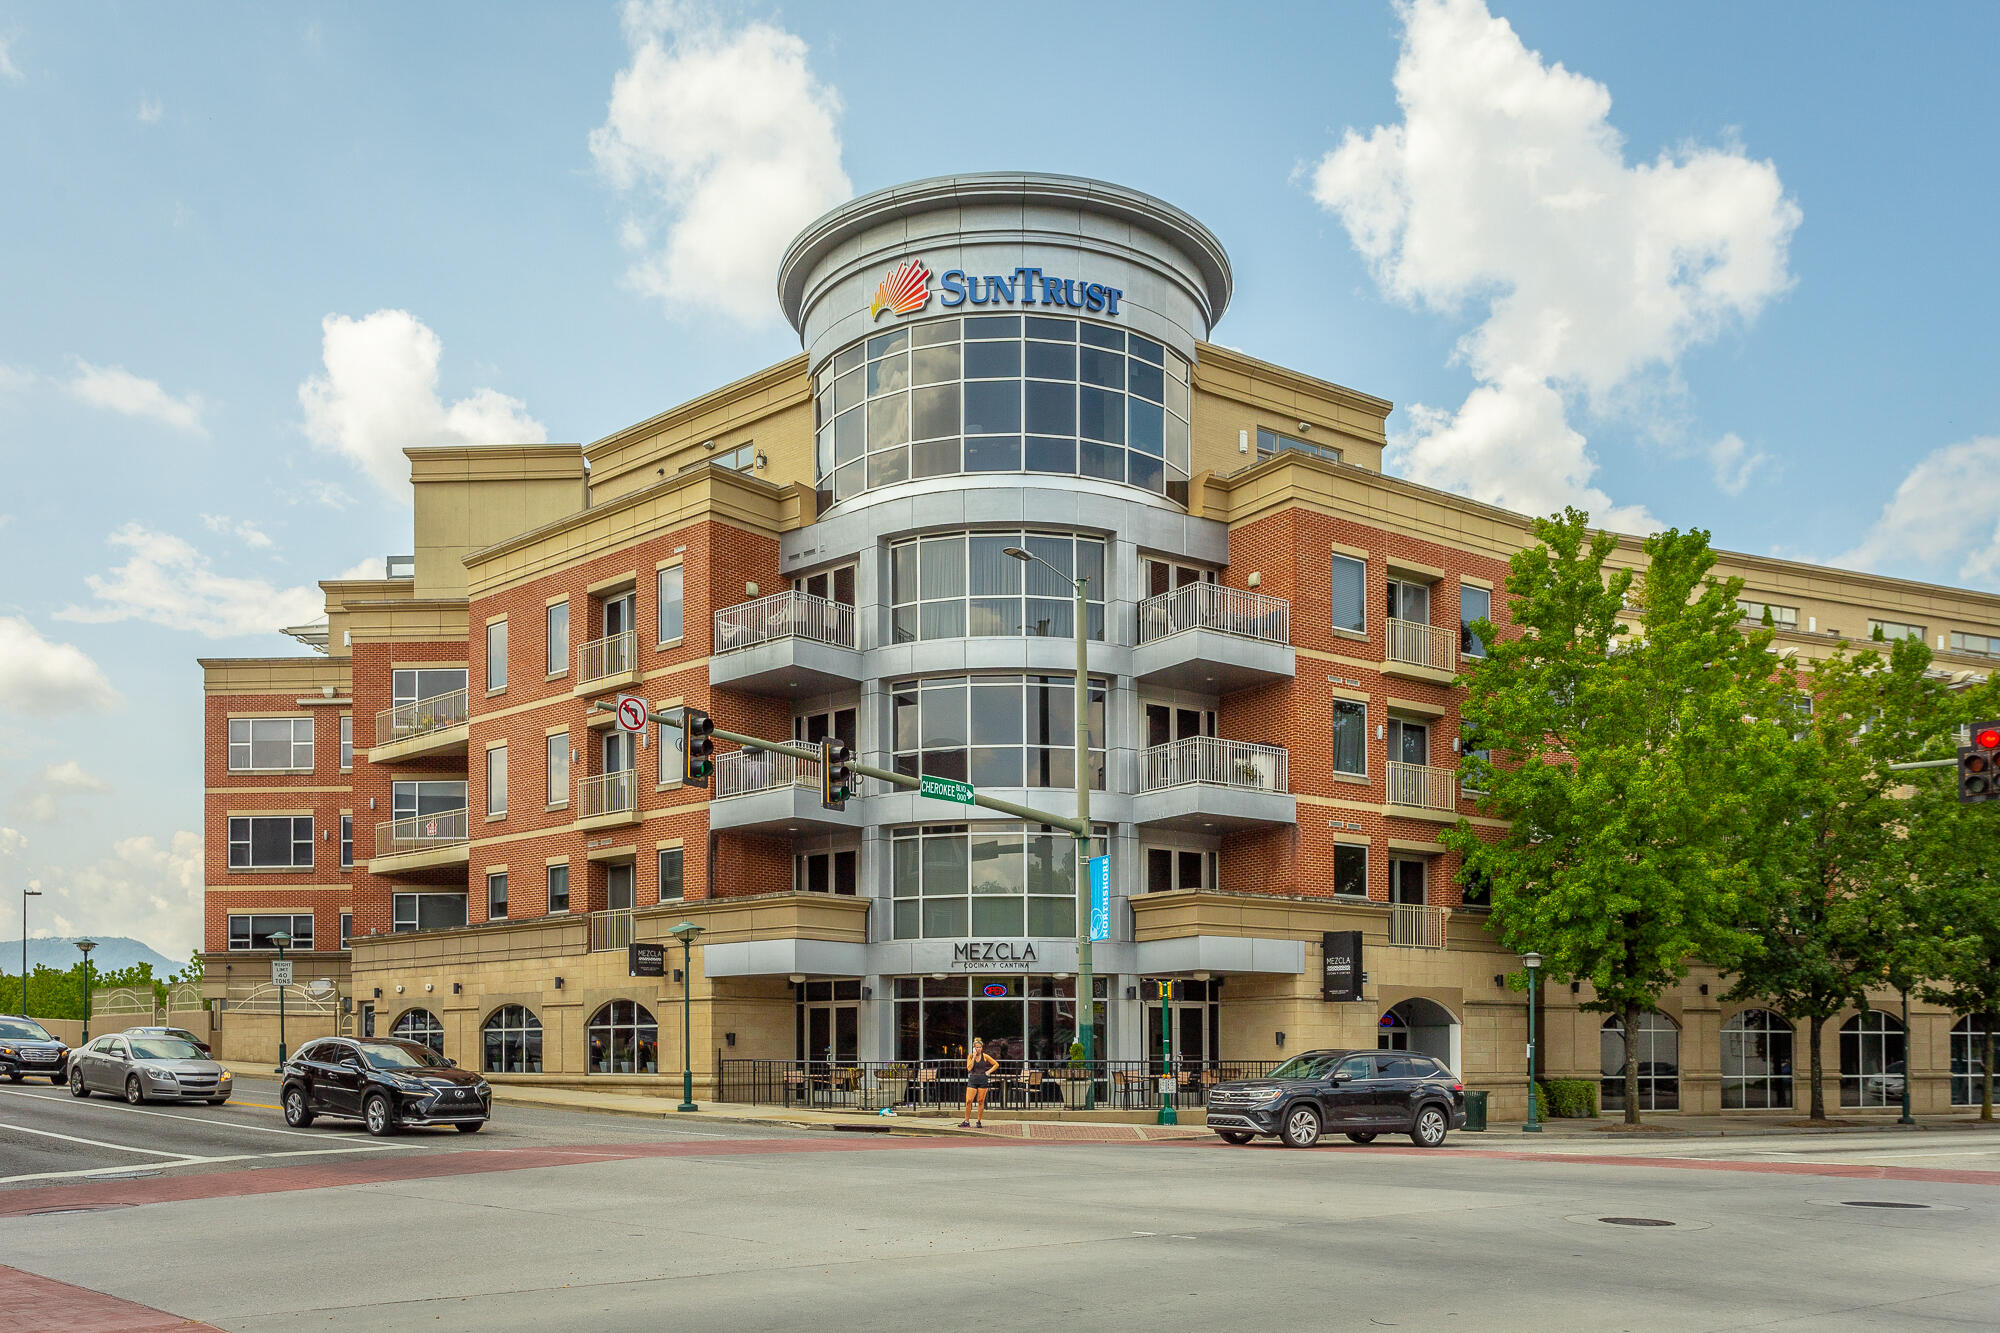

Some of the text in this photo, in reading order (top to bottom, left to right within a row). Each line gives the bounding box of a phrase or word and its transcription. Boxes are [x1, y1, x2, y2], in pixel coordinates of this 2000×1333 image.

[921, 780, 967, 797] CHEROKEE BLVD
[954, 942, 1036, 960] MEZCLA
[1326, 957, 1351, 965] MEZCLA
[984, 986, 1005, 996] OPEN
